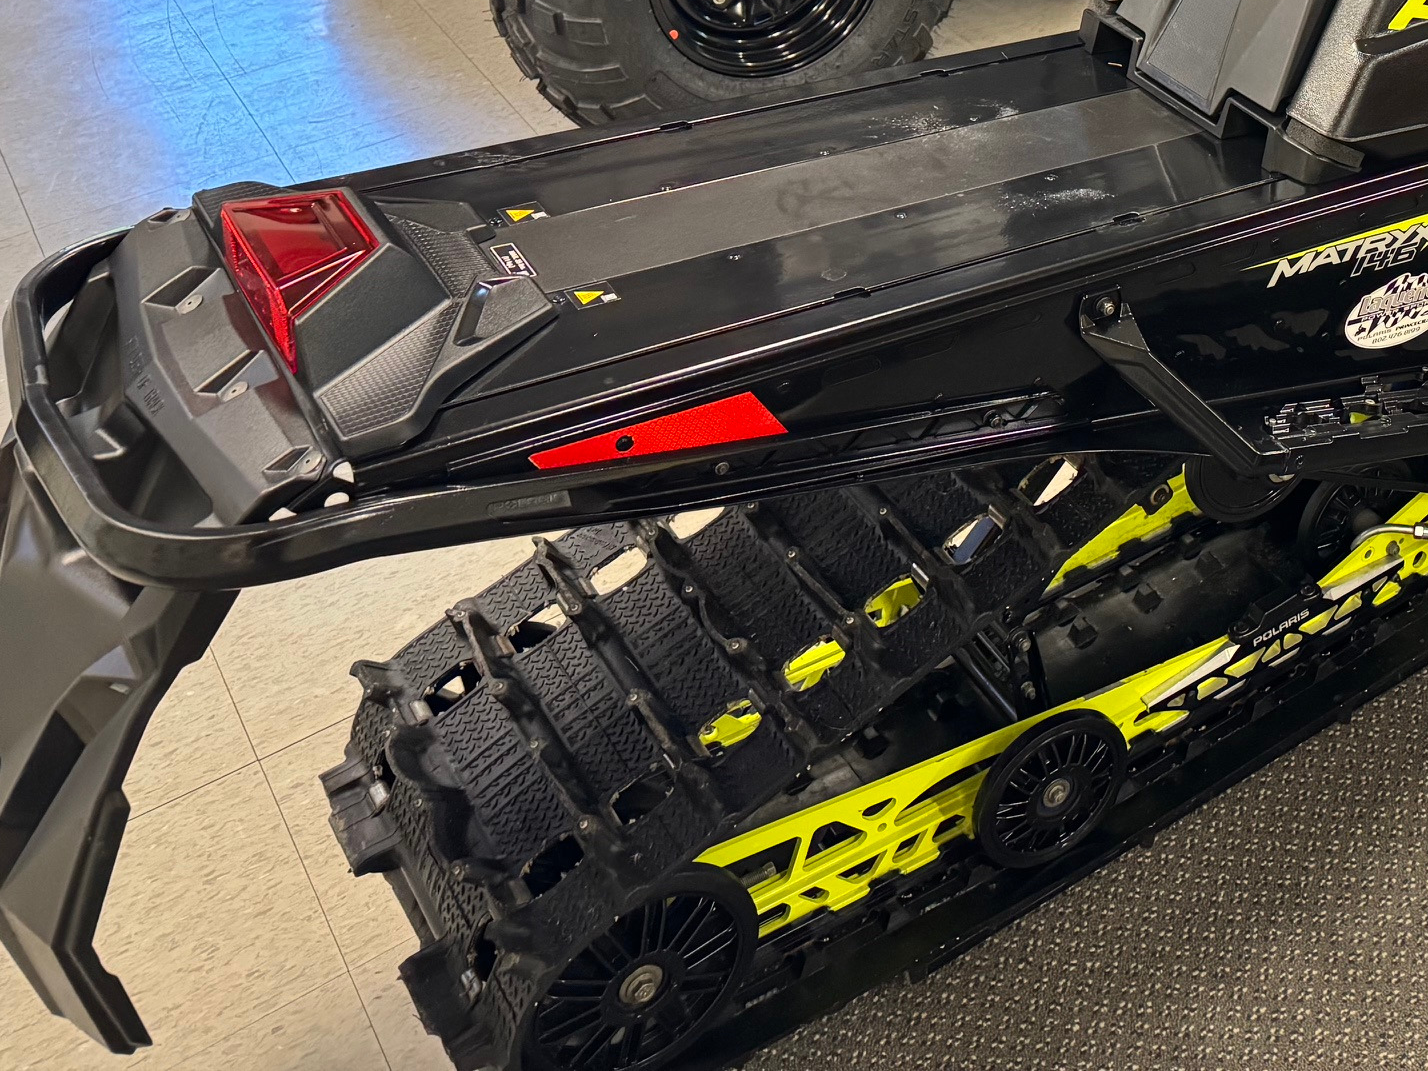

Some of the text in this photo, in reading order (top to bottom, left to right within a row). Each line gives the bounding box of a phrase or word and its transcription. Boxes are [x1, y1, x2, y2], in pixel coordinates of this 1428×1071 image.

[1350, 242, 1419, 277] 146
[1357, 329, 1392, 341] POLARIS
[1253, 608, 1310, 647] POLARIS
